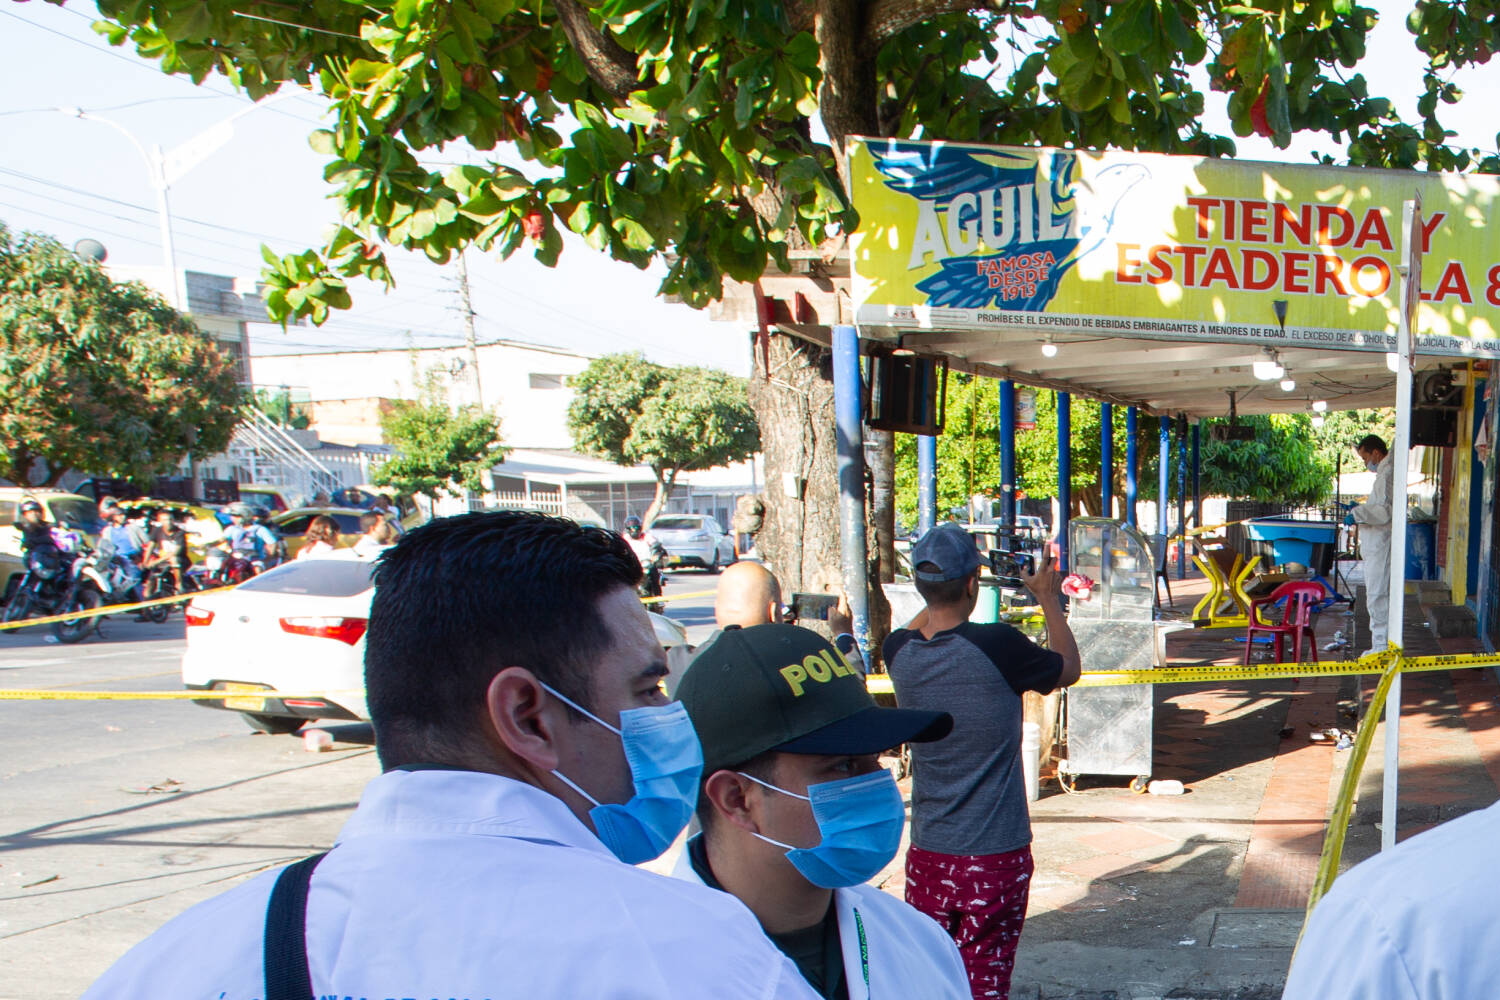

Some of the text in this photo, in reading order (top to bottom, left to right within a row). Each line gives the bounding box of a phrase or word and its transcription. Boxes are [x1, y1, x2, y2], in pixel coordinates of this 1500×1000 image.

[1187, 197, 1394, 251] TIENDA
[977, 251, 1057, 276] FAMOSA
[988, 267, 1049, 289] DESDE
[1115, 243, 1391, 298] ESTADERO
[1001, 284, 1036, 301] 1913
[1027, 315, 1036, 325] EL
[1039, 316, 1080, 327] EXPENDIO
[1082, 318, 1093, 328] DE
[1095, 319, 1131, 330] BEBIDAS
[1133, 321, 1198, 334] EMBRIAGANTES
[1200, 325, 1206, 334] A
[1208, 326, 1248, 336] MENORES
[1250, 328, 1262, 337] DE
[1292, 330, 1301, 339] EL
[1303, 331, 1334, 341] EXCESO
[1336, 332, 1347, 342] DE
[1449, 339, 1471, 349] PAR
